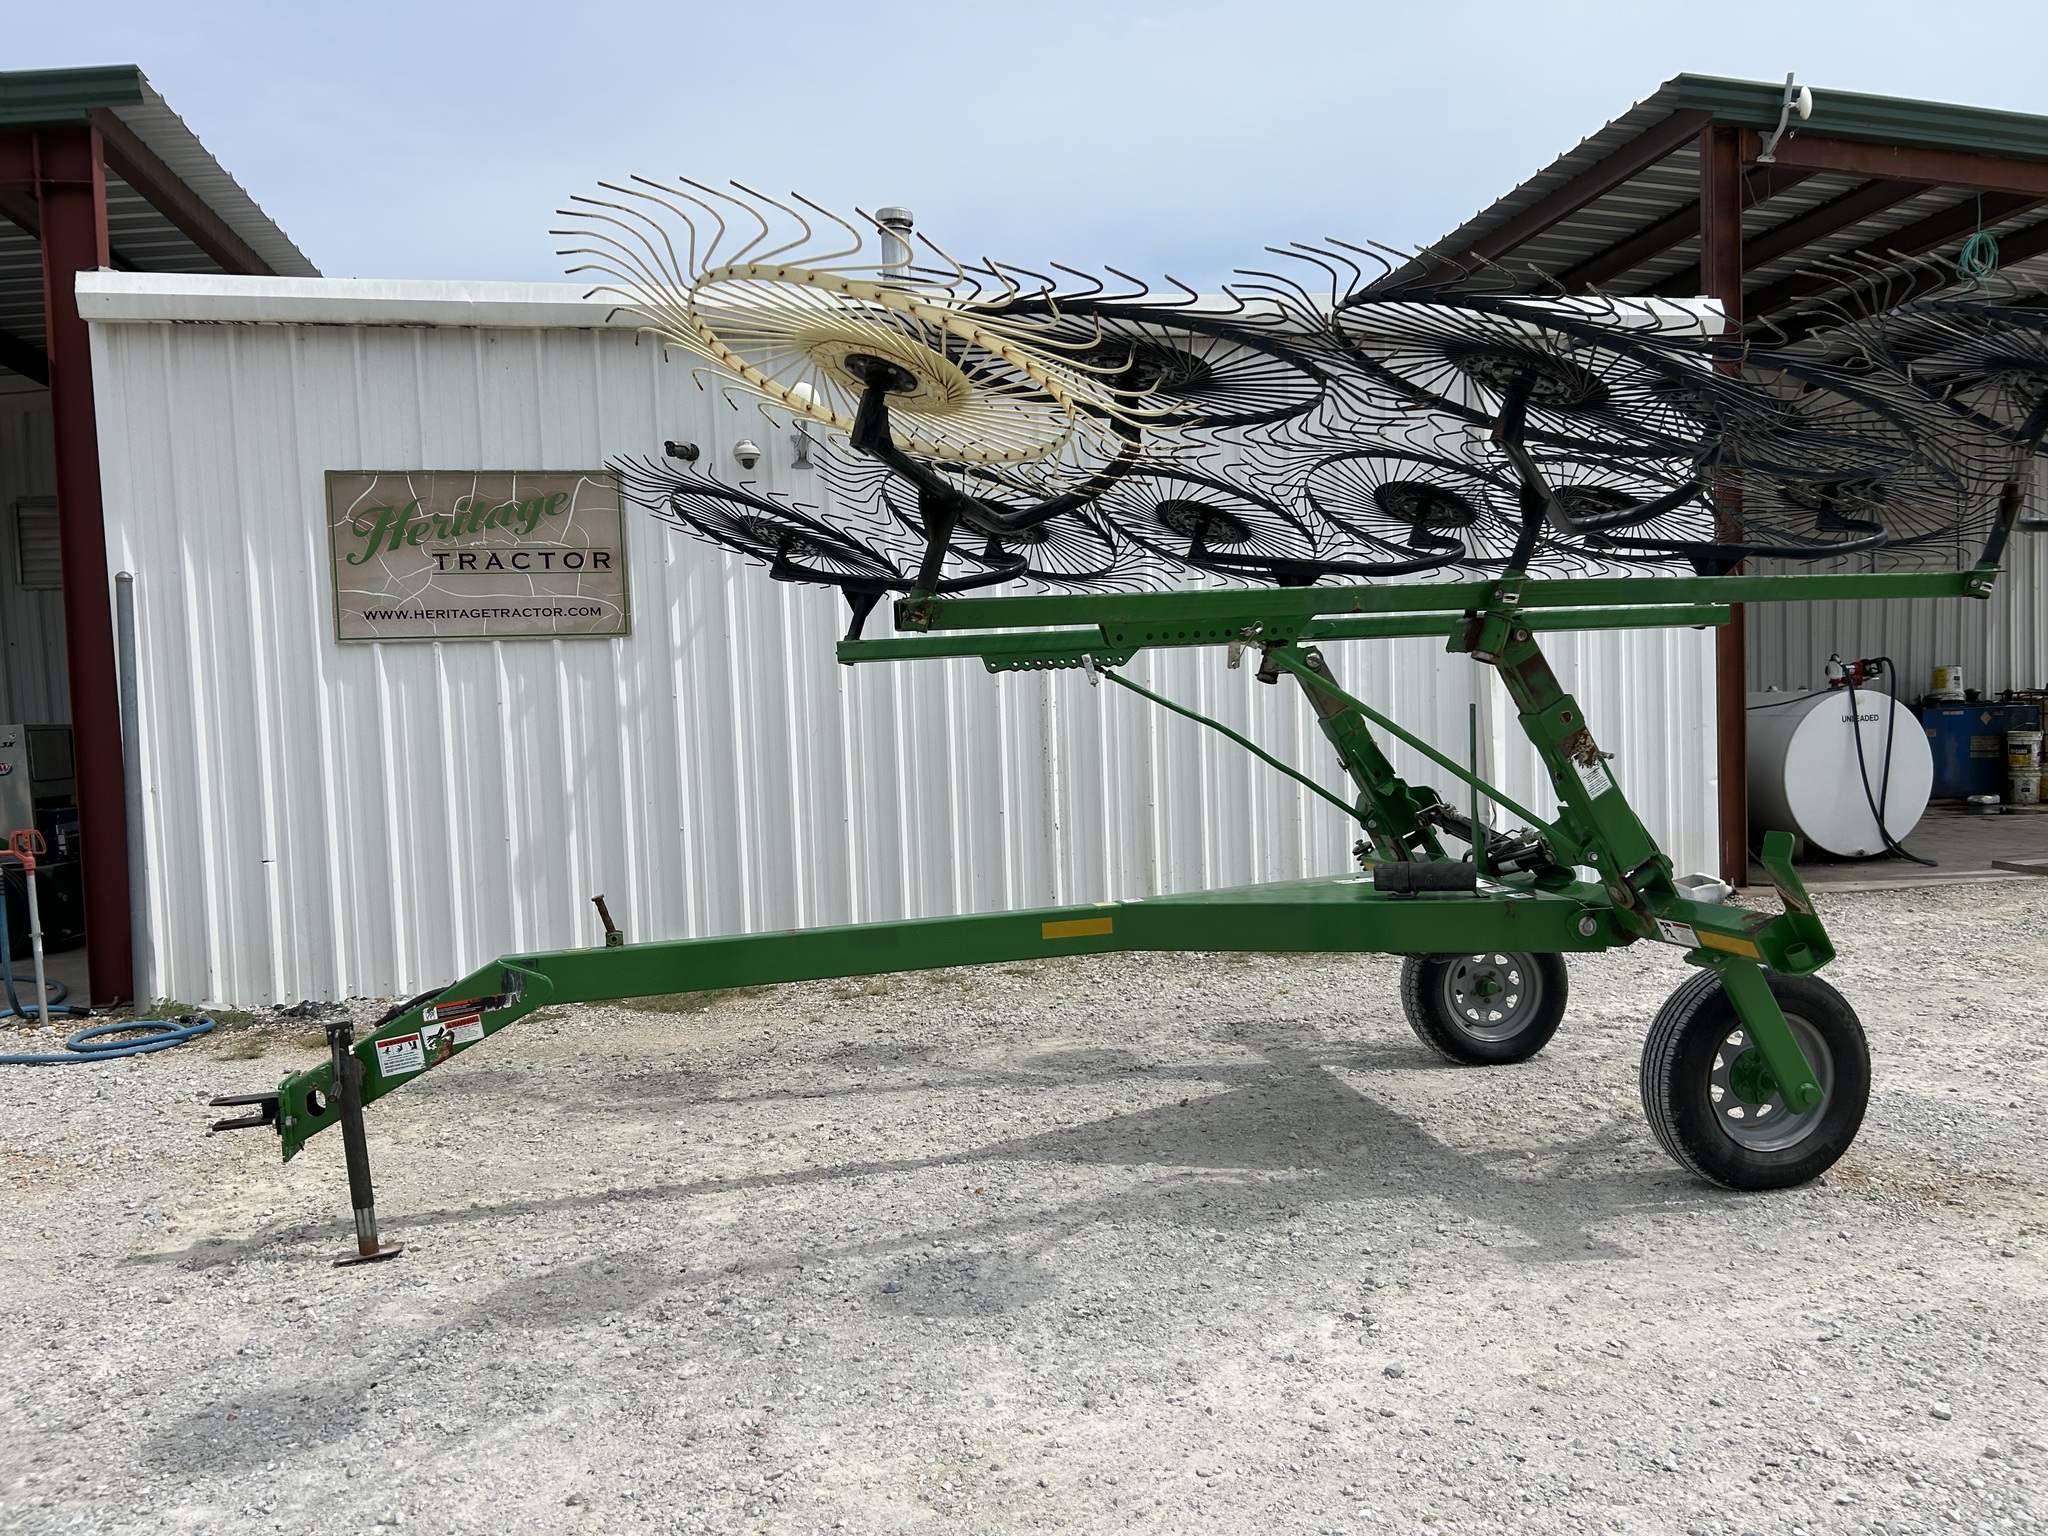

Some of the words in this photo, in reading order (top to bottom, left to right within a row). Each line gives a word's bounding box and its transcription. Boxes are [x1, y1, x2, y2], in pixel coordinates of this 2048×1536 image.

[346, 491, 572, 566] Heritage
[432, 552, 612, 571] TRACTOR
[363, 607, 602, 621] WWW.HERITAGETRACTOR.COM
